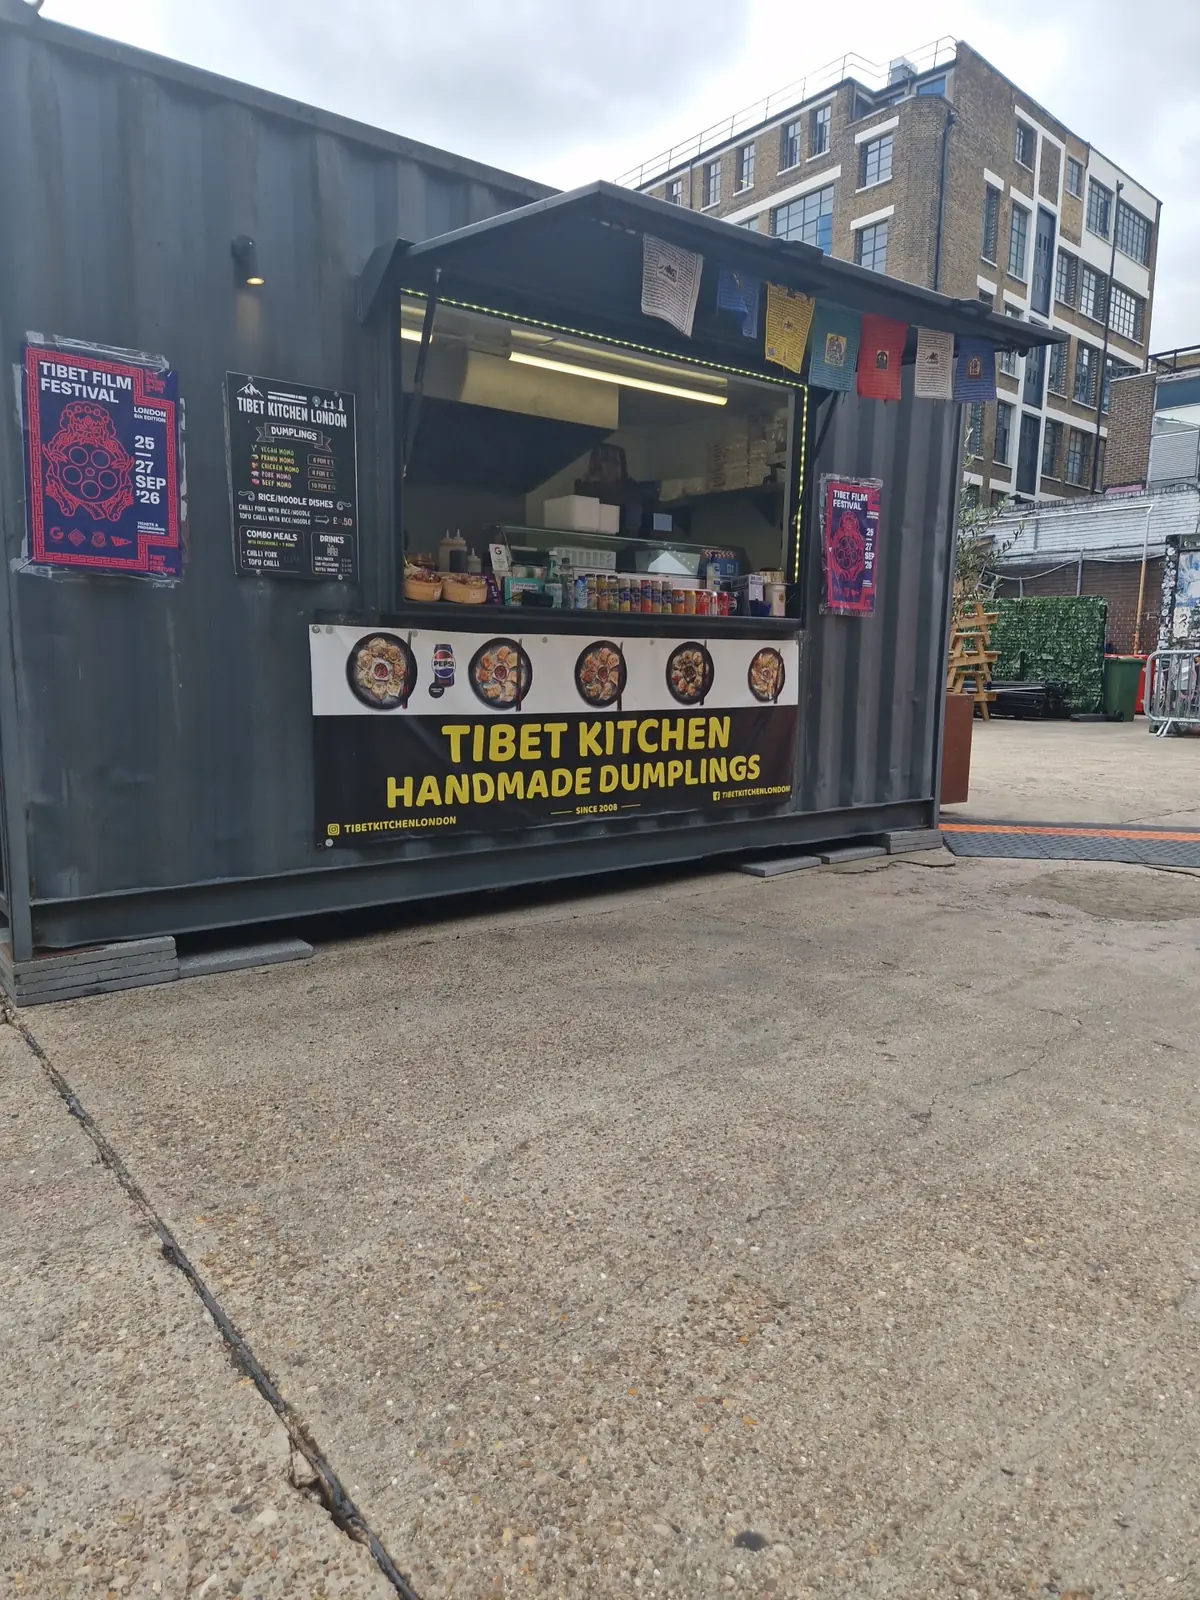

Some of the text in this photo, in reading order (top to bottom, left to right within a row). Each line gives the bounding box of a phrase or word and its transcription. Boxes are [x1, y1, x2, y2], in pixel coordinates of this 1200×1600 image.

[40, 362, 88, 381] TIBET
[92, 371, 131, 390] FILM
[41, 378, 119, 403] FESTIVAL
[134, 406, 166, 417] LONDON
[237, 397, 347, 428] TIBET KITCHEN LONDON
[270, 426, 317, 441] DUMPLINGS
[135, 435, 154, 450] 25
[135, 460, 154, 473] 27
[136, 475, 166, 489] SEP
[136, 490, 160, 504] '26
[258, 493, 334, 508] RICE/NOODLE DISHES
[833, 490, 868, 501] TIBET FILM
[280, 507, 311, 516] RICE/NOODLE
[833, 500, 862, 510] FESTIVAL
[282, 516, 311, 525] RICE/NOODLE
[246, 530, 298, 541] COMBO MEALS
[866, 528, 874, 536] 25
[320, 535, 344, 544] DRINKS
[865, 543, 872, 551] 27
[865, 552, 875, 560] SEP
[441, 716, 730, 763] TIBET KITCHEN
[387, 755, 760, 808] HANDMADE DUMPLINGS
[722, 785, 791, 799] TIBETKITCHENLONDON
[576, 804, 618, 814] SINCE 2008
[344, 816, 456, 833] TIBETKITCHENLONDON
